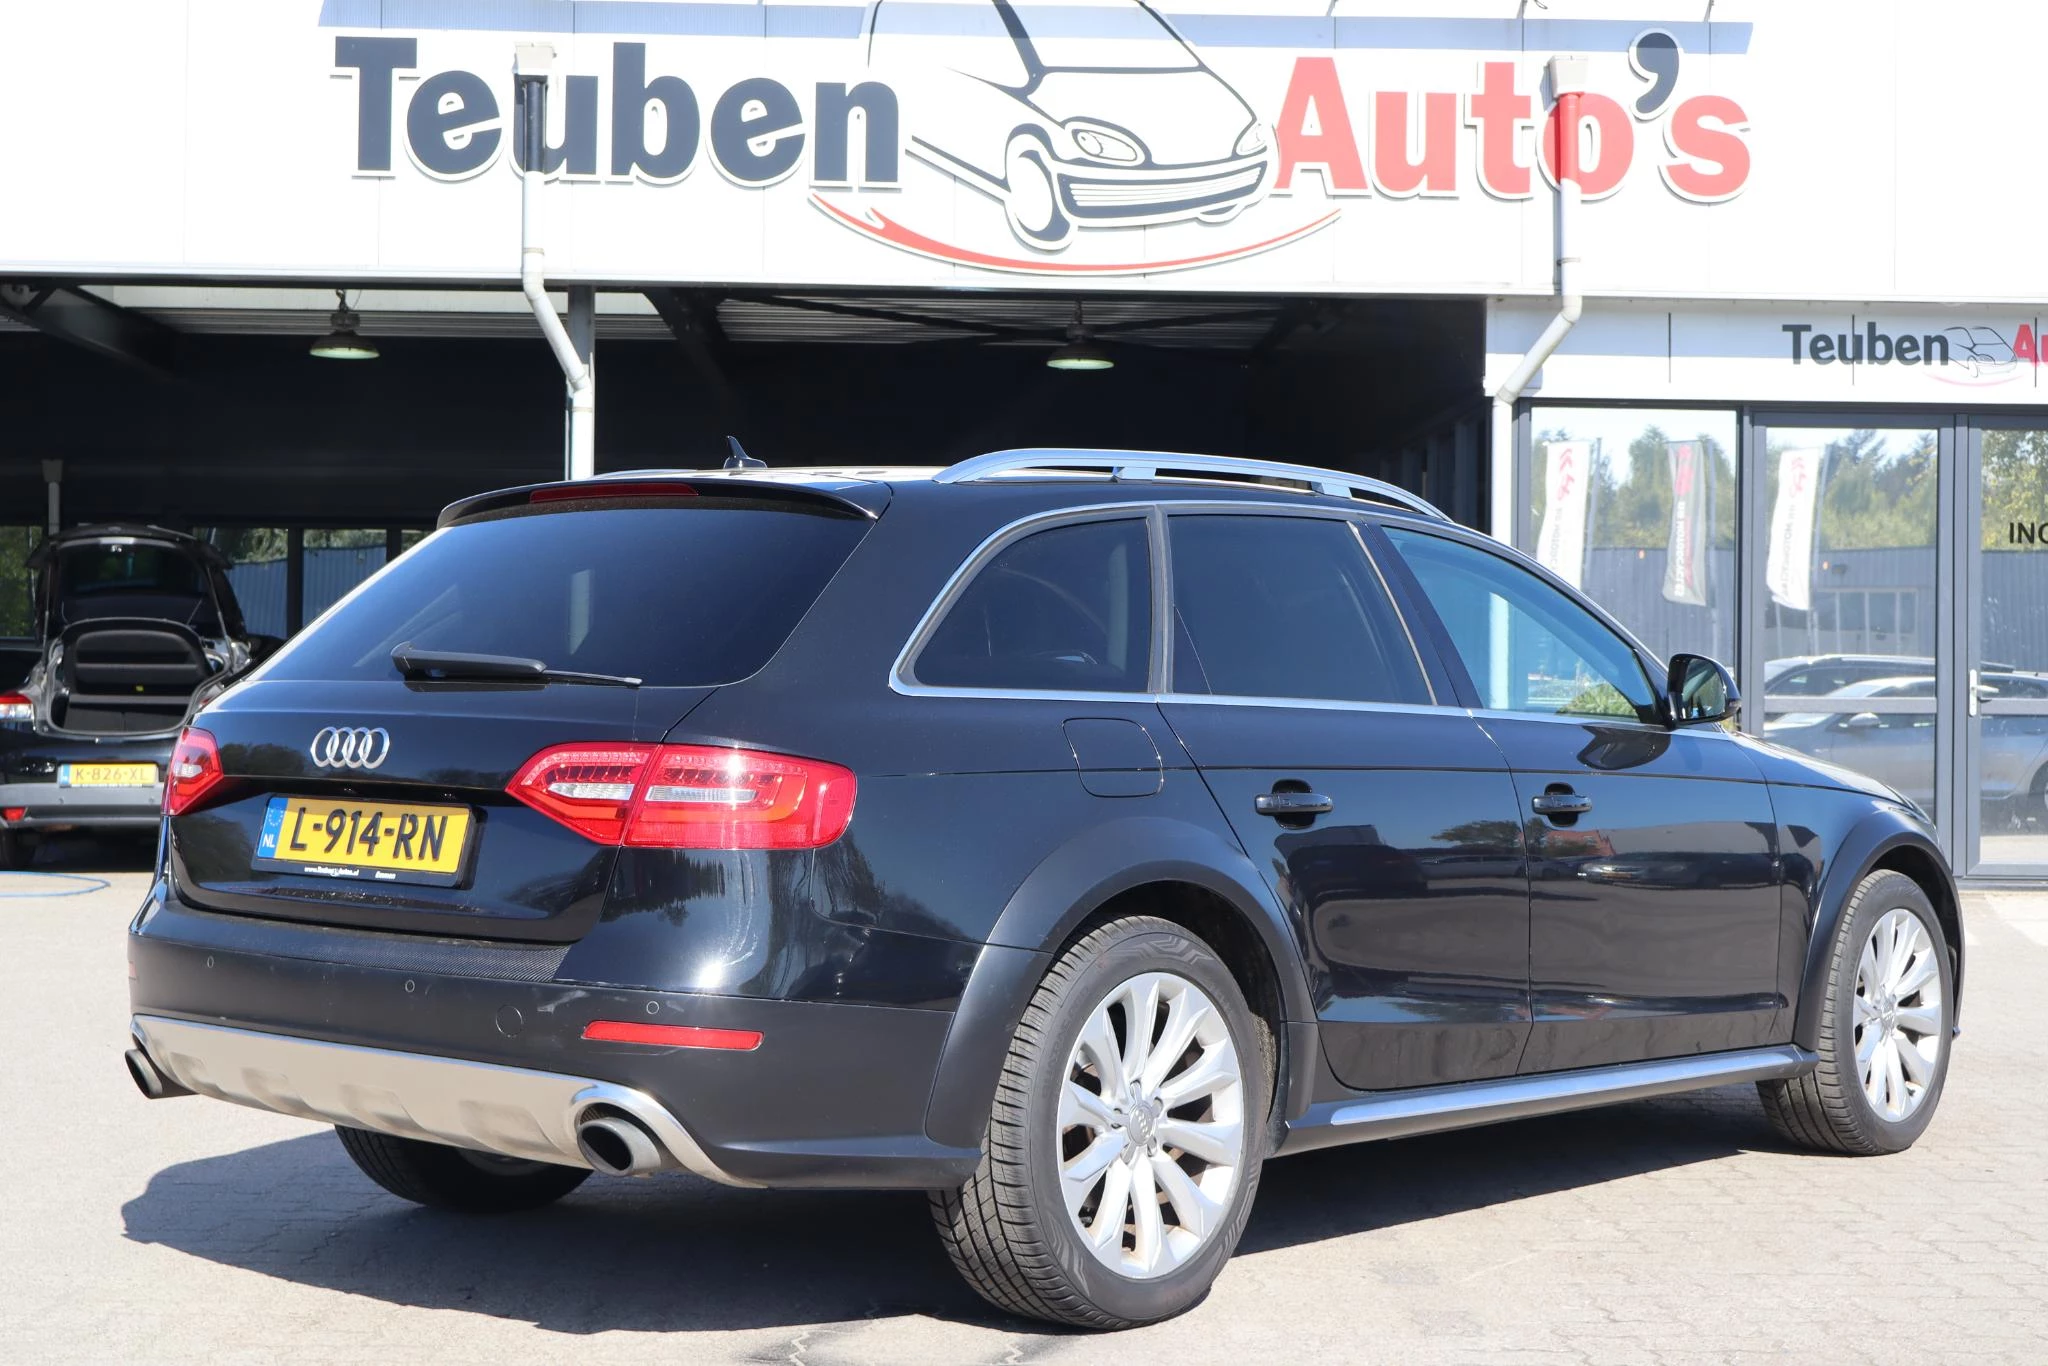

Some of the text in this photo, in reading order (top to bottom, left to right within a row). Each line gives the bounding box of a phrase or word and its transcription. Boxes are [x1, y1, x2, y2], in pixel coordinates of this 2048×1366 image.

[333, 30, 1751, 201] Teuben Auto's
[1782, 321, 2048, 367] Teuben A
[75, 767, 149, 781] K-826-XL
[262, 807, 449, 862] NL L-914-RN
